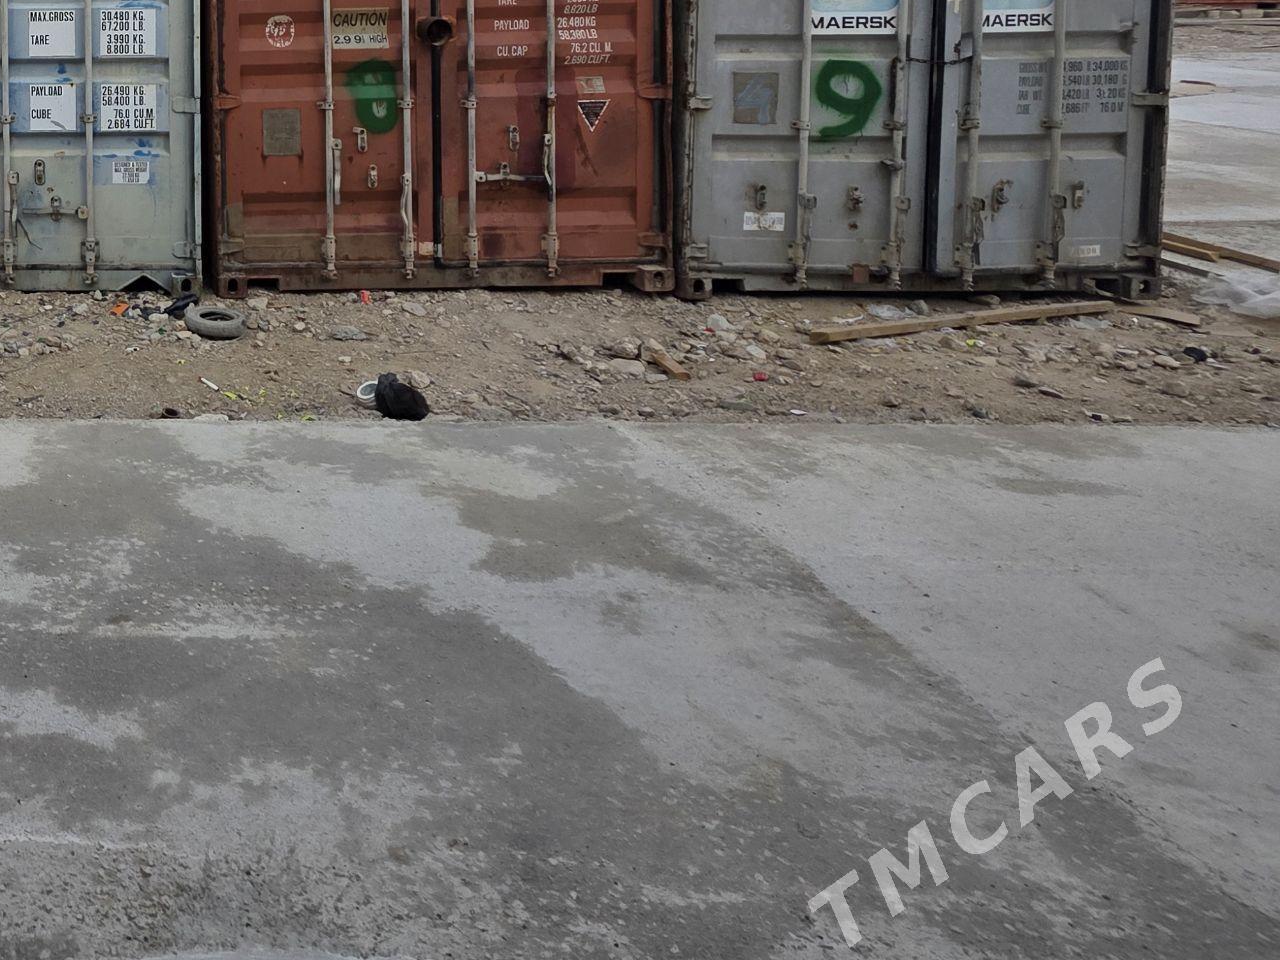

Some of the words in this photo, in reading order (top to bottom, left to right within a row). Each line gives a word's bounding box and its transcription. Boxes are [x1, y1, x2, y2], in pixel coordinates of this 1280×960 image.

[587, 4, 598, 14] LB
[102, 11, 129, 21] 30.480
[333, 13, 387, 27] CAUTION
[102, 21, 129, 31] 67.200
[494, 20, 530, 31] PAYLOAD
[585, 16, 596, 26] KG
[811, 16, 896, 29] MAERSK
[587, 29, 598, 39] LB
[30, 35, 49, 45] TARE
[333, 35, 351, 44] 2.9
[511, 46, 528, 56] CAP
[31, 86, 63, 96] PAYLOAD
[816, 59, 882, 142] 9
[32, 109, 51, 119] CUBE
